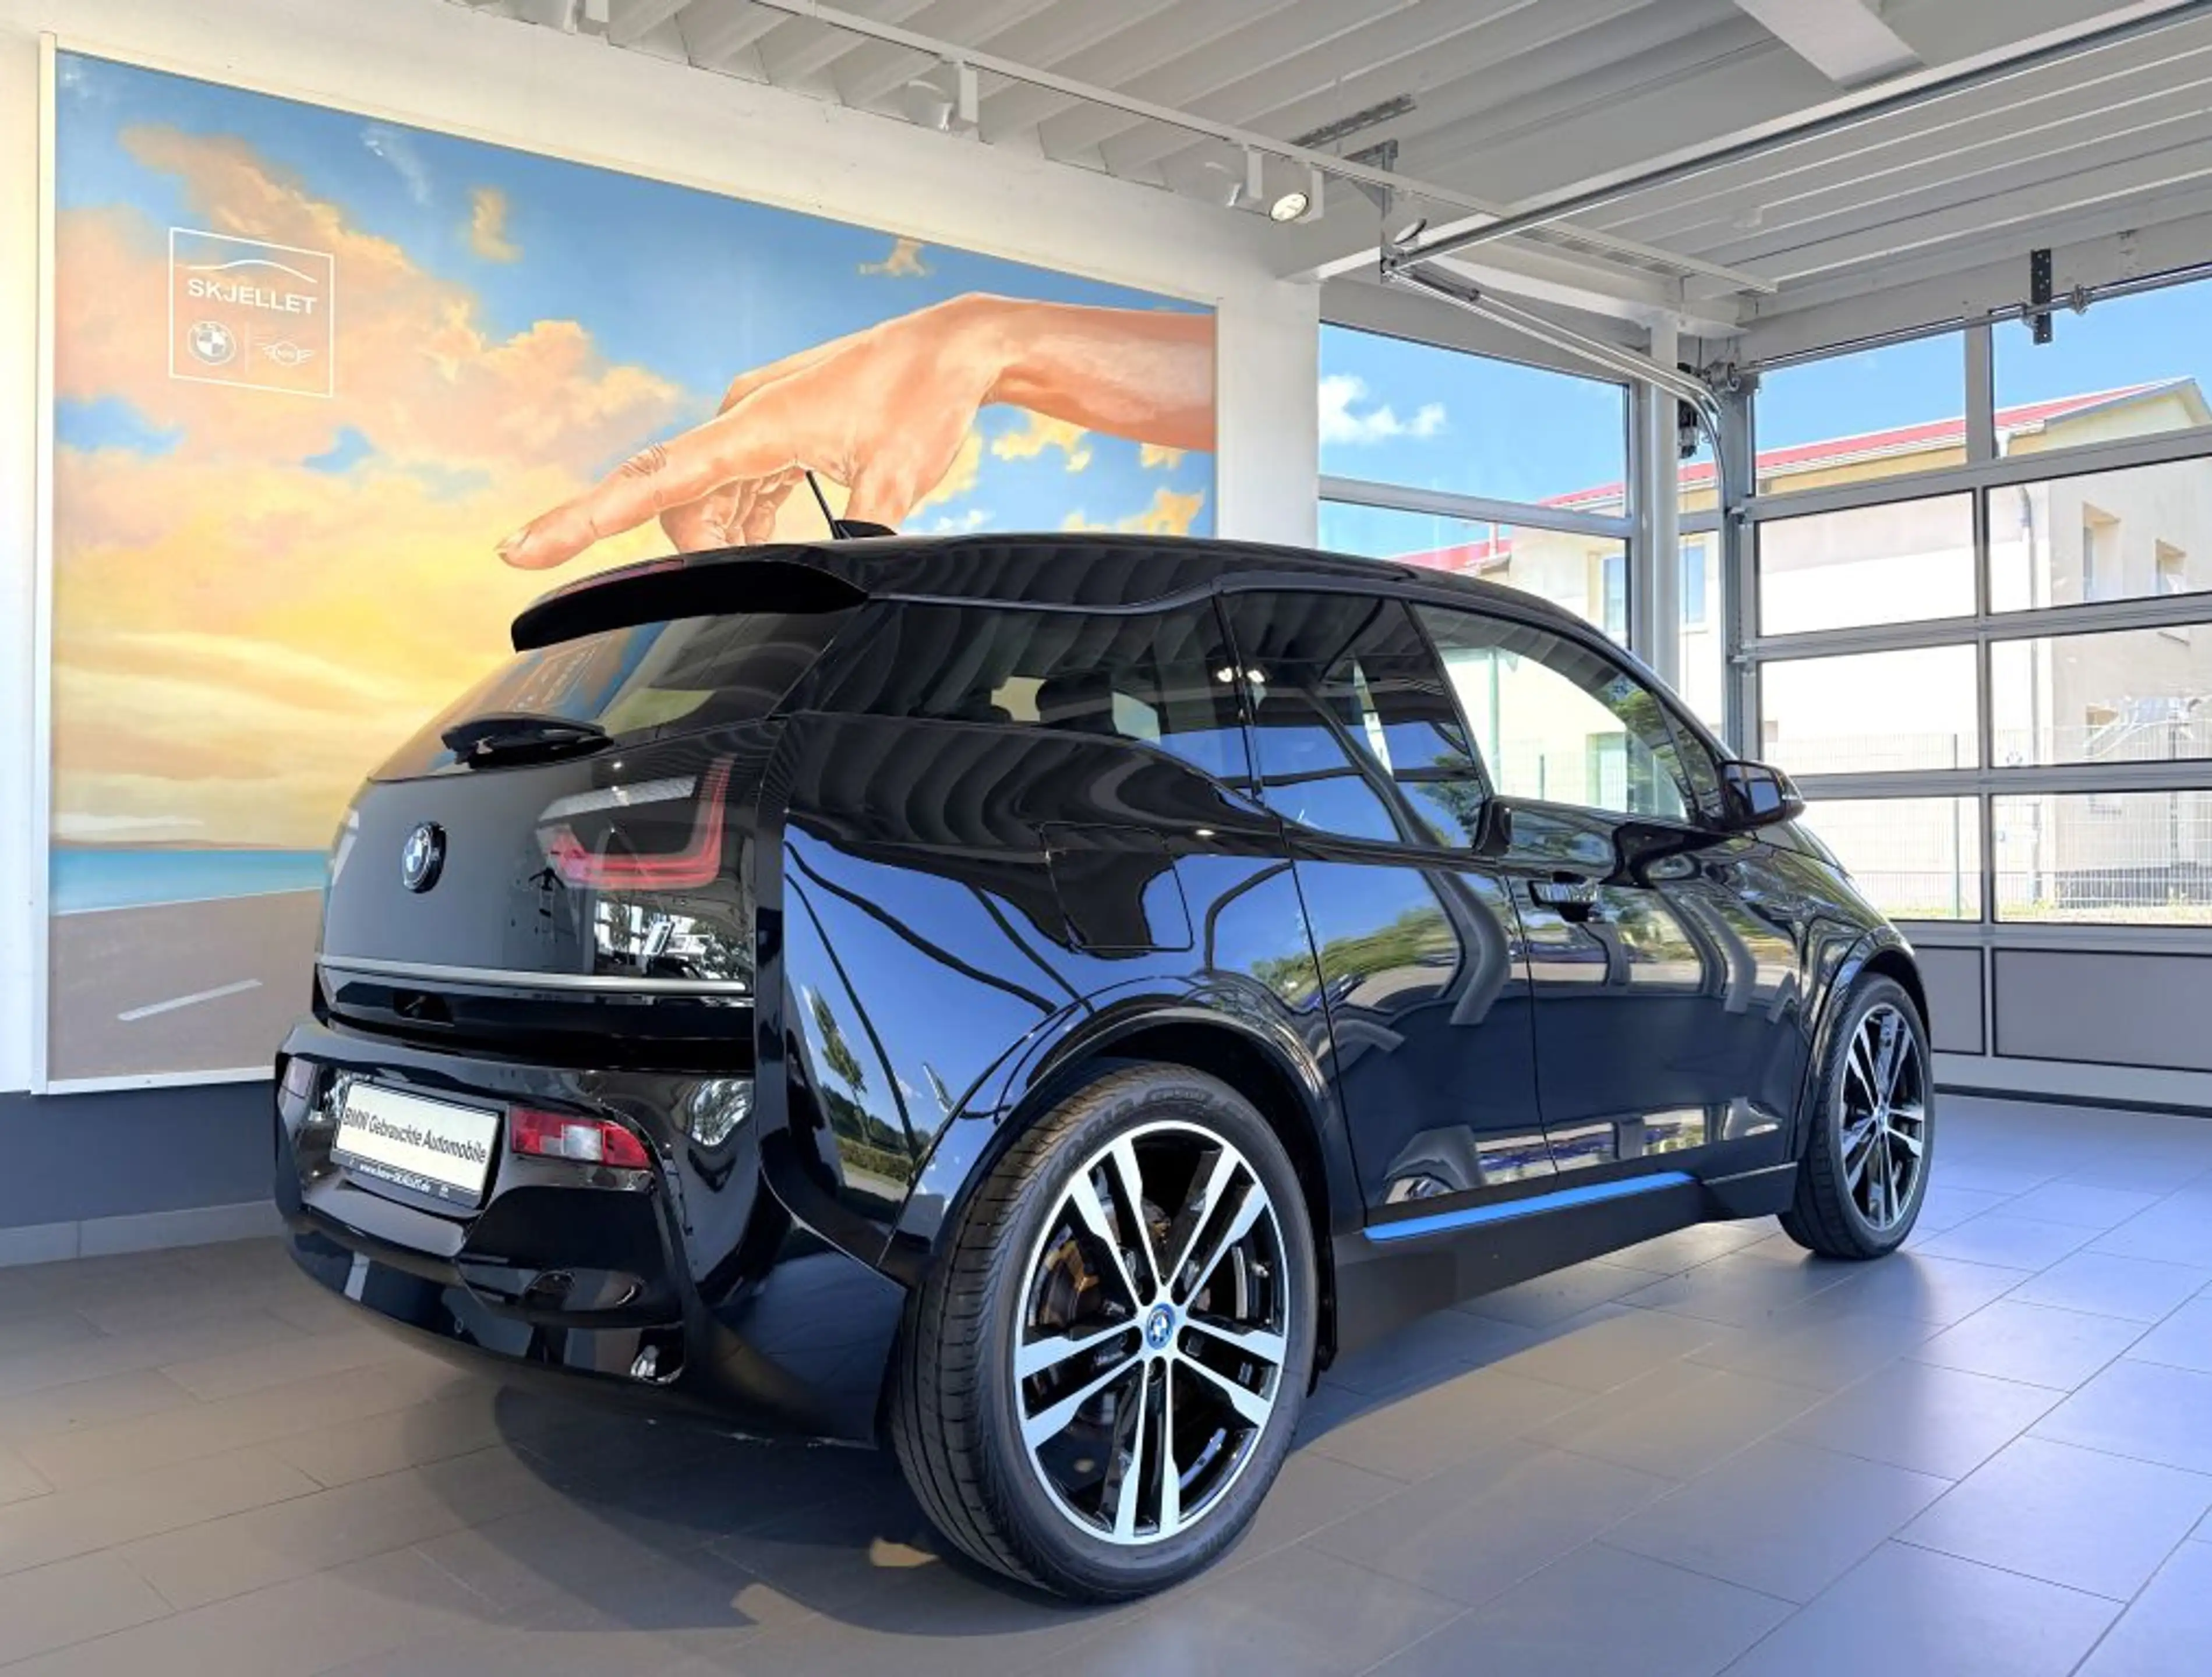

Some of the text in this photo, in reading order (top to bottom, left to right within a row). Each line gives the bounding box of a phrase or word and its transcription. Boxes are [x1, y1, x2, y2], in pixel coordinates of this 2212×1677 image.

[188, 277, 318, 315] SKJELLET
[342, 1107, 486, 1163] BMW Gebrauchte Automobile
